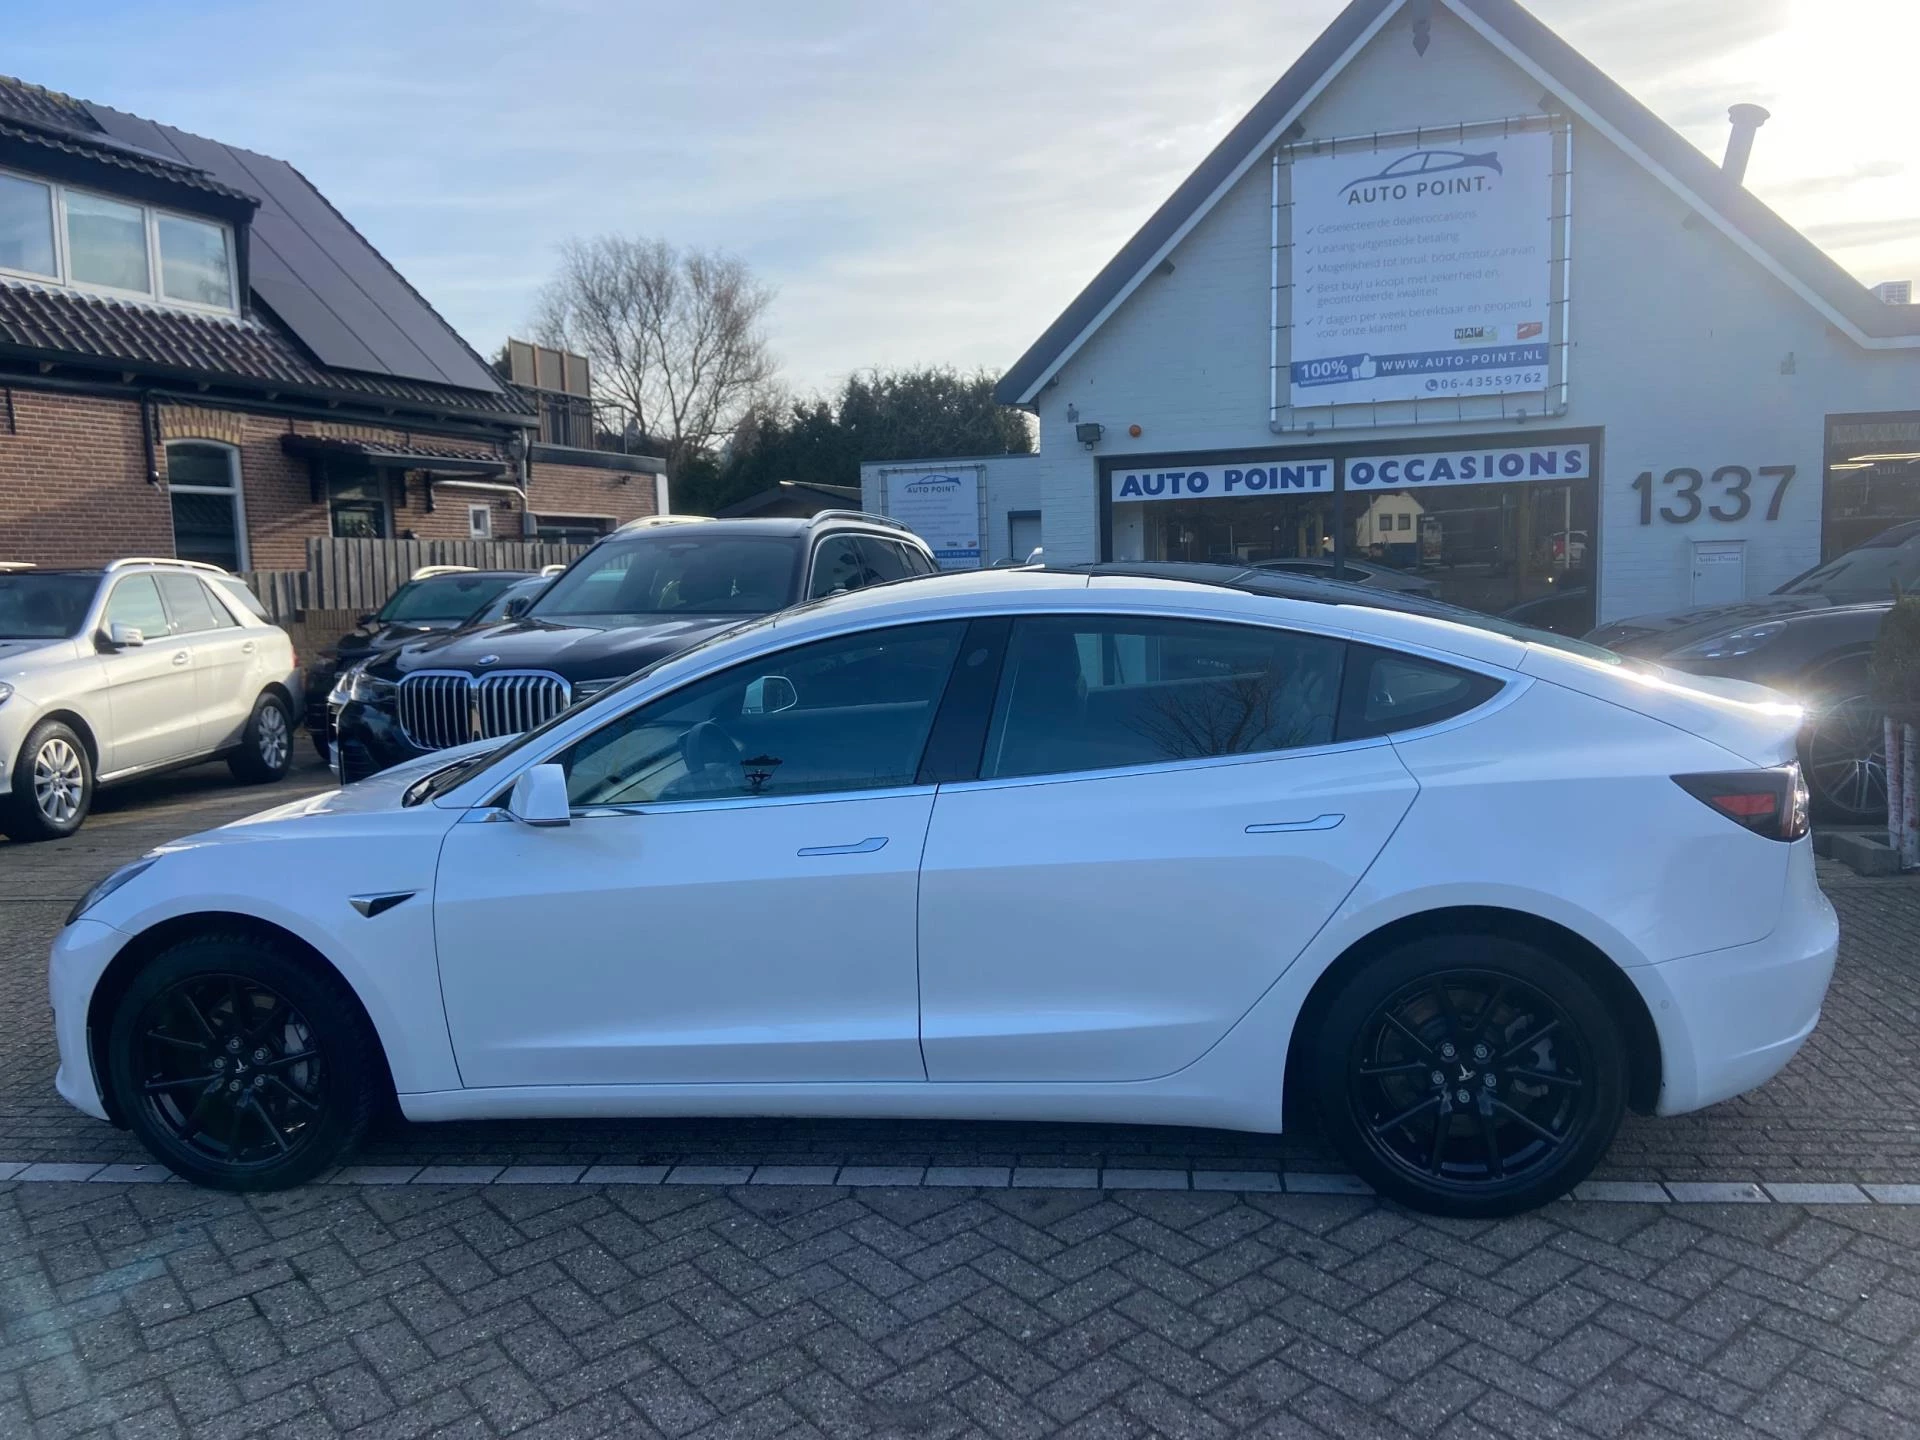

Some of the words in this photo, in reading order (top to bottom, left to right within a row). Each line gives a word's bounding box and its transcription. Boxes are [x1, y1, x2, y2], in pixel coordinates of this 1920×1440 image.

[1348, 184, 1407, 205] AUTO
[1416, 176, 1492, 198] POINT.
[1417, 231, 1460, 245] betaling
[1317, 259, 1381, 274] Mogelijkheid
[1383, 257, 1397, 267] tot
[1317, 283, 1339, 294] Best
[1366, 280, 1373, 288] u
[1375, 277, 1404, 290] koopt
[1407, 274, 1427, 284] met
[1430, 269, 1482, 284] zekerheid
[1317, 291, 1394, 308] gecontroleerde
[1397, 287, 1438, 299] kwaliteit
[1318, 315, 1325, 325] 7
[1327, 313, 1358, 325] dagen
[1360, 312, 1377, 323] per
[1380, 309, 1407, 319] week
[1468, 303, 1481, 313] en
[1317, 328, 1339, 338] voor
[1342, 326, 1366, 337] onze
[1368, 322, 1407, 335] klanten
[1300, 360, 1348, 379] 100%
[1382, 350, 1543, 371] WWW.AUTO-POINT.NL
[1441, 372, 1542, 390] 06-43559762
[1350, 449, 1583, 486] OCCASIONS
[1119, 471, 1210, 497] AUTO
[1224, 464, 1328, 492] POINT
[1630, 464, 1797, 526] 1337
